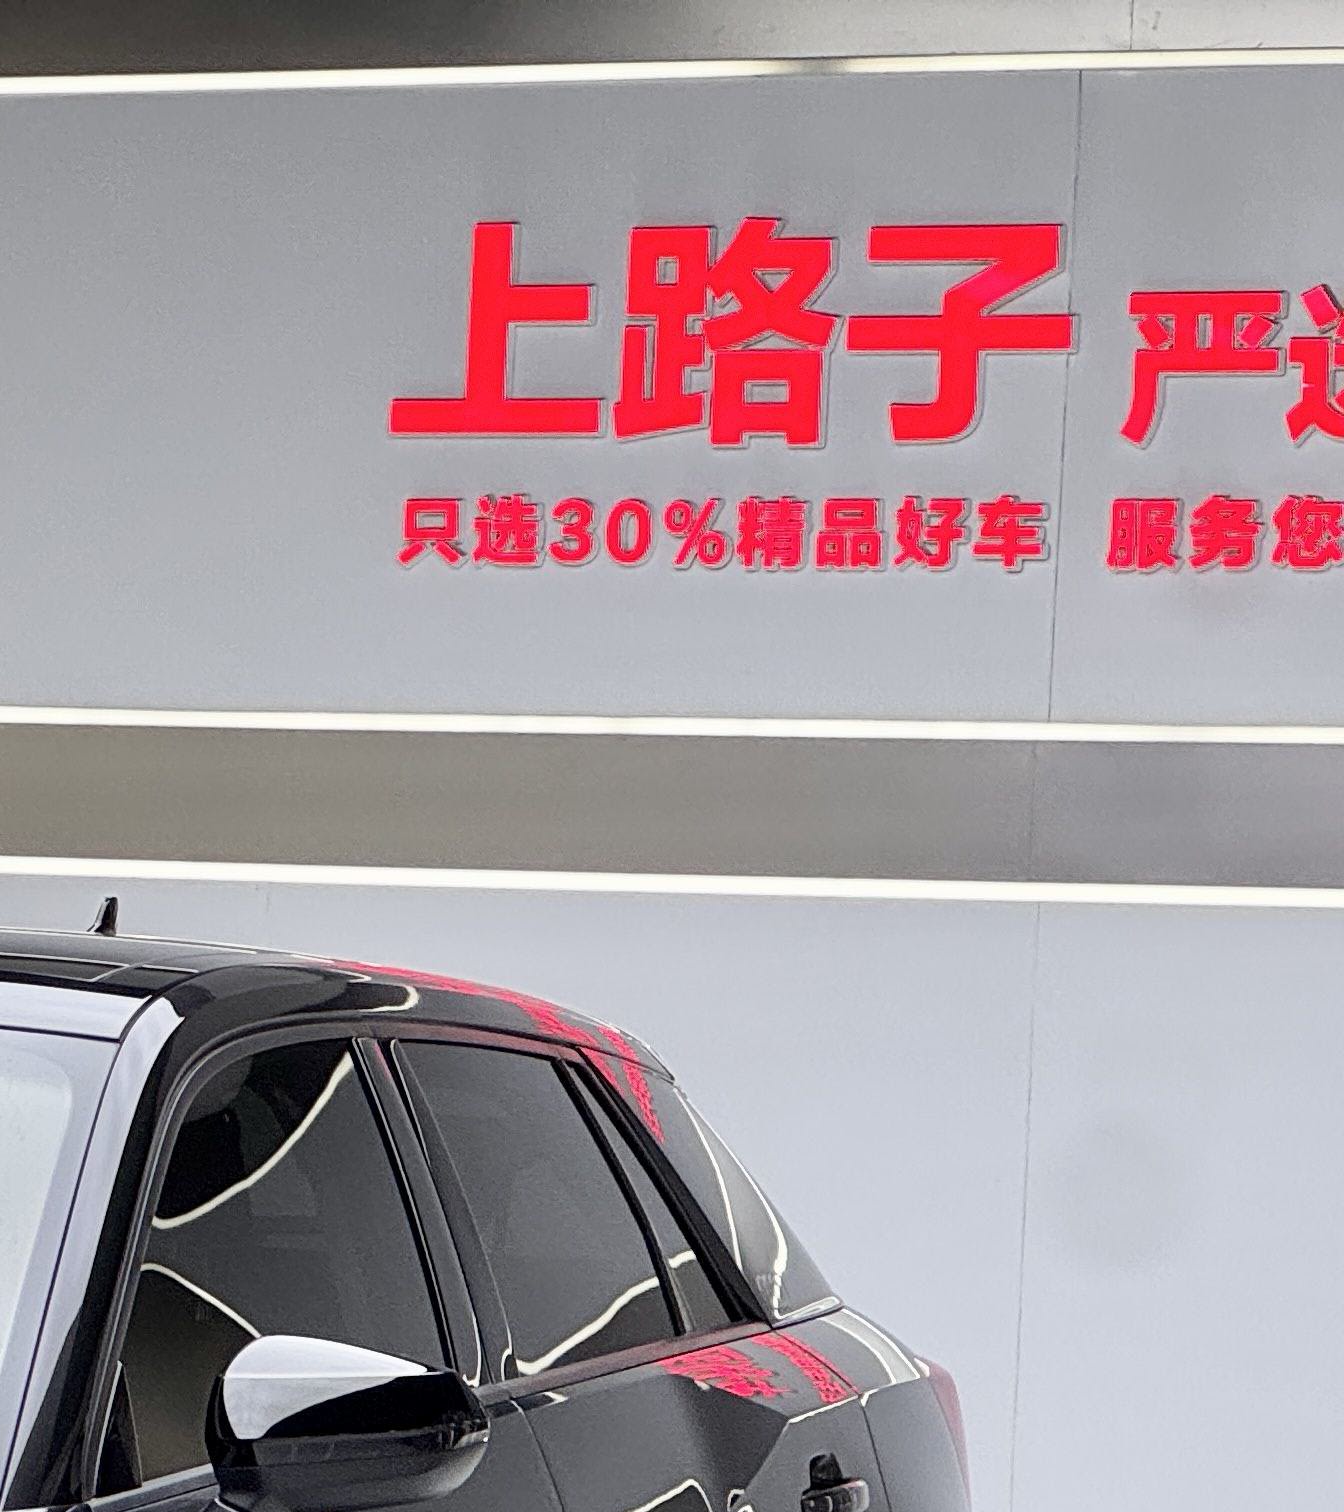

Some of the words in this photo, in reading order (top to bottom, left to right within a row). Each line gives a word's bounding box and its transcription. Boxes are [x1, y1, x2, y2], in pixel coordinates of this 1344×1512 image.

[388, 216, 1076, 448] 上路子
[396, 494, 1047, 571] 只选30%精品好车
[1105, 494, 1344, 571] 服务您
